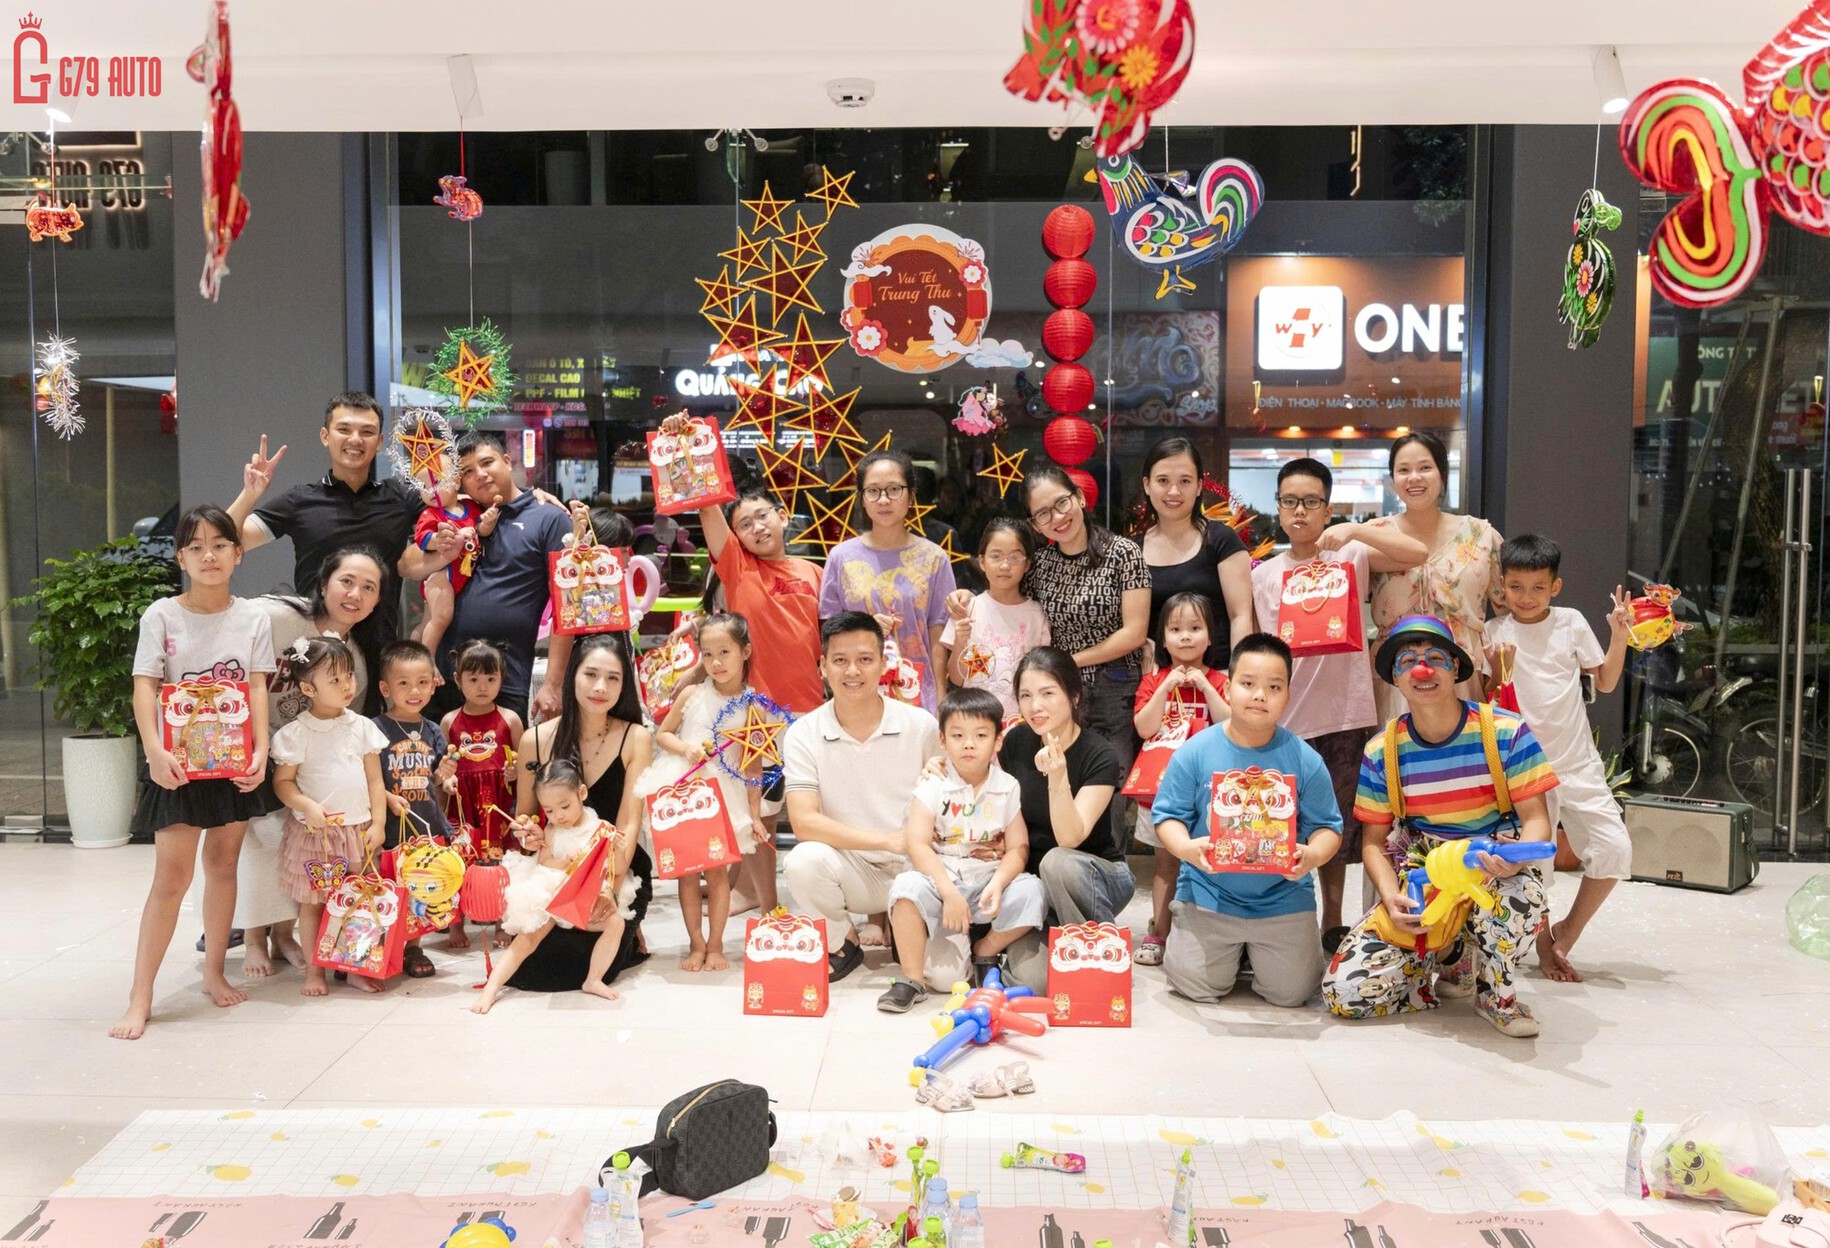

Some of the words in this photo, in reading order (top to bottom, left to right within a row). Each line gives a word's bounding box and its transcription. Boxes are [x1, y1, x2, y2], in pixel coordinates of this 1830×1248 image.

[898, 272, 917, 284] Vui
[919, 269, 937, 284] Tết
[878, 286, 920, 304] Trung
[925, 283, 952, 299] Thu
[1698, 344, 1724, 359] ÔNG
[388, 752, 435, 770] MUSIC
[402, 790, 430, 802] SOUL
